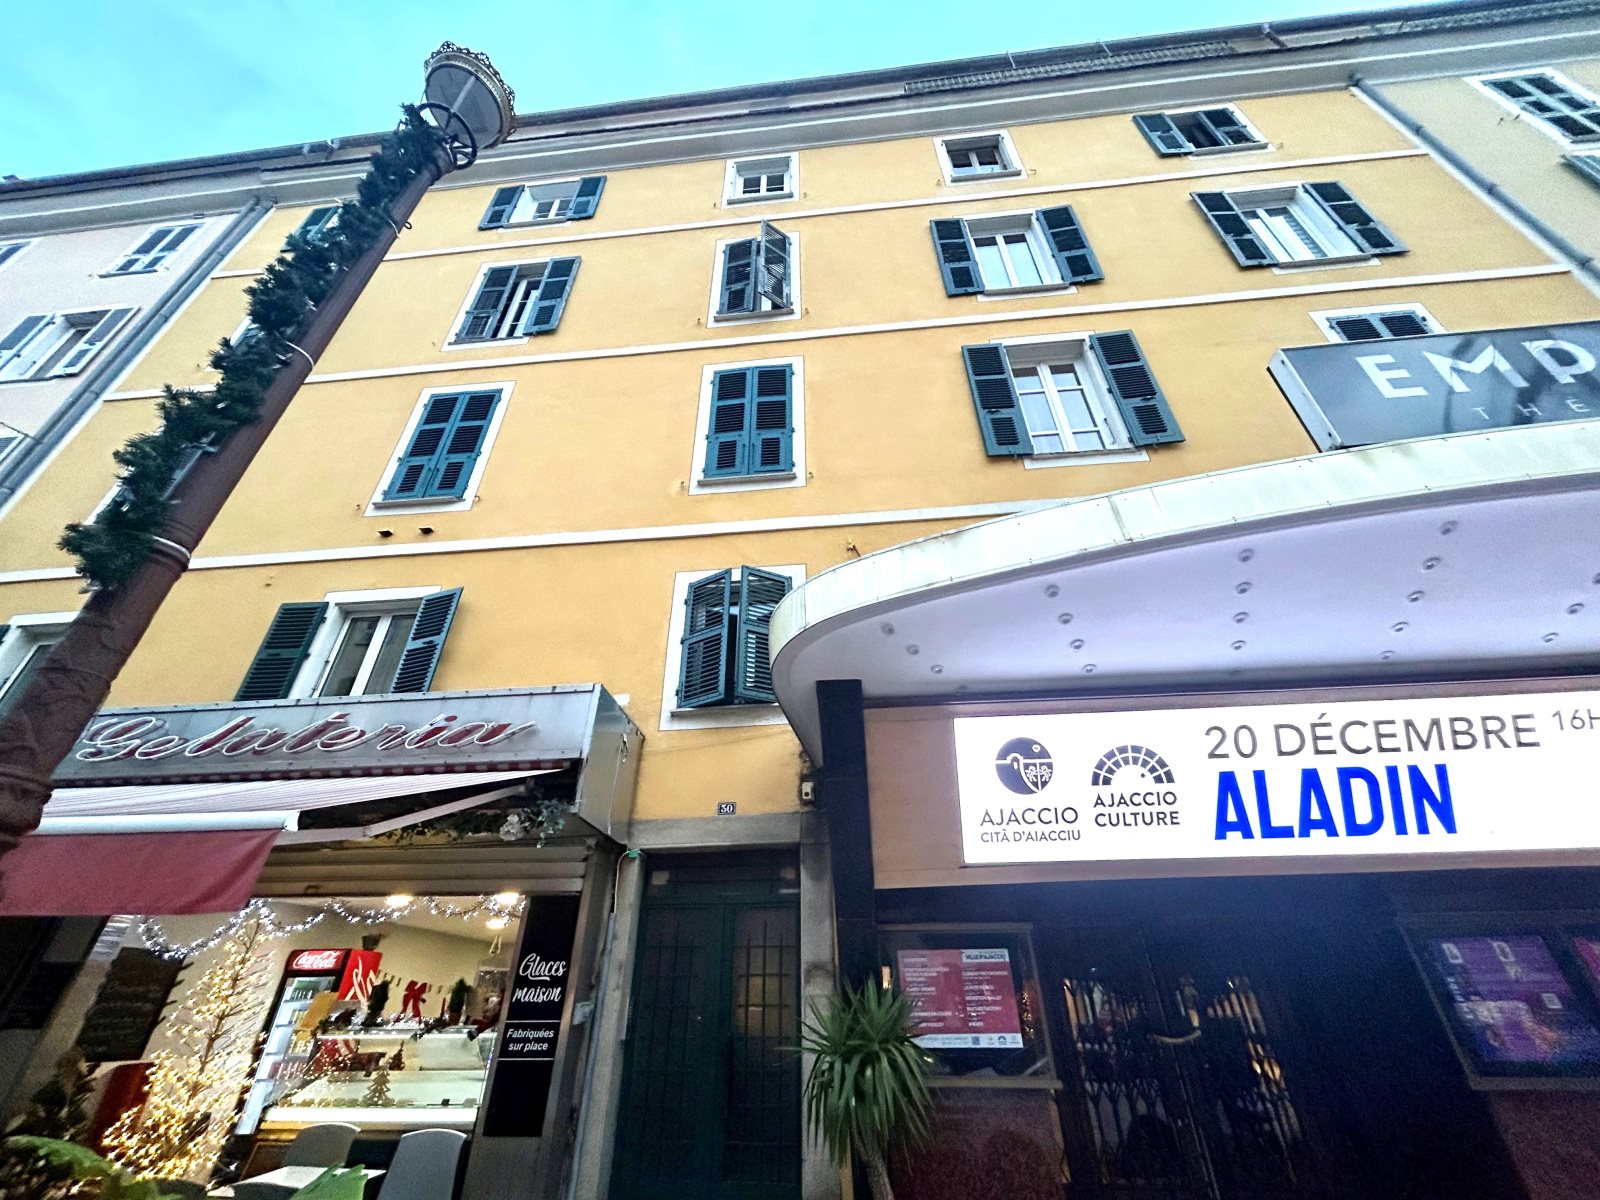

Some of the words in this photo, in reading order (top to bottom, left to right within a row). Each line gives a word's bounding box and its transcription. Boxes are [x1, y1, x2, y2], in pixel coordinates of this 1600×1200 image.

[1355, 339, 1596, 398] EMP
[76, 711, 537, 762] Gelateria
[1204, 723, 1259, 760] 20
[1273, 712, 1541, 758] DÉCEMBRE
[1093, 791, 1178, 808] AJACCIO
[1214, 763, 1458, 840] ALADIN
[720, 804, 733, 813] 30
[980, 806, 1079, 827] AJACCIO
[1094, 811, 1180, 828] CULTURE
[980, 828, 1010, 843] CITÀ
[1013, 829, 1081, 842] D'AIACCIU
[519, 953, 567, 981] Glaces
[512, 986, 562, 1003] maison
[506, 1027, 555, 1040] Fabriquées
[508, 1042, 523, 1051] sur
[523, 1041, 549, 1053] place
